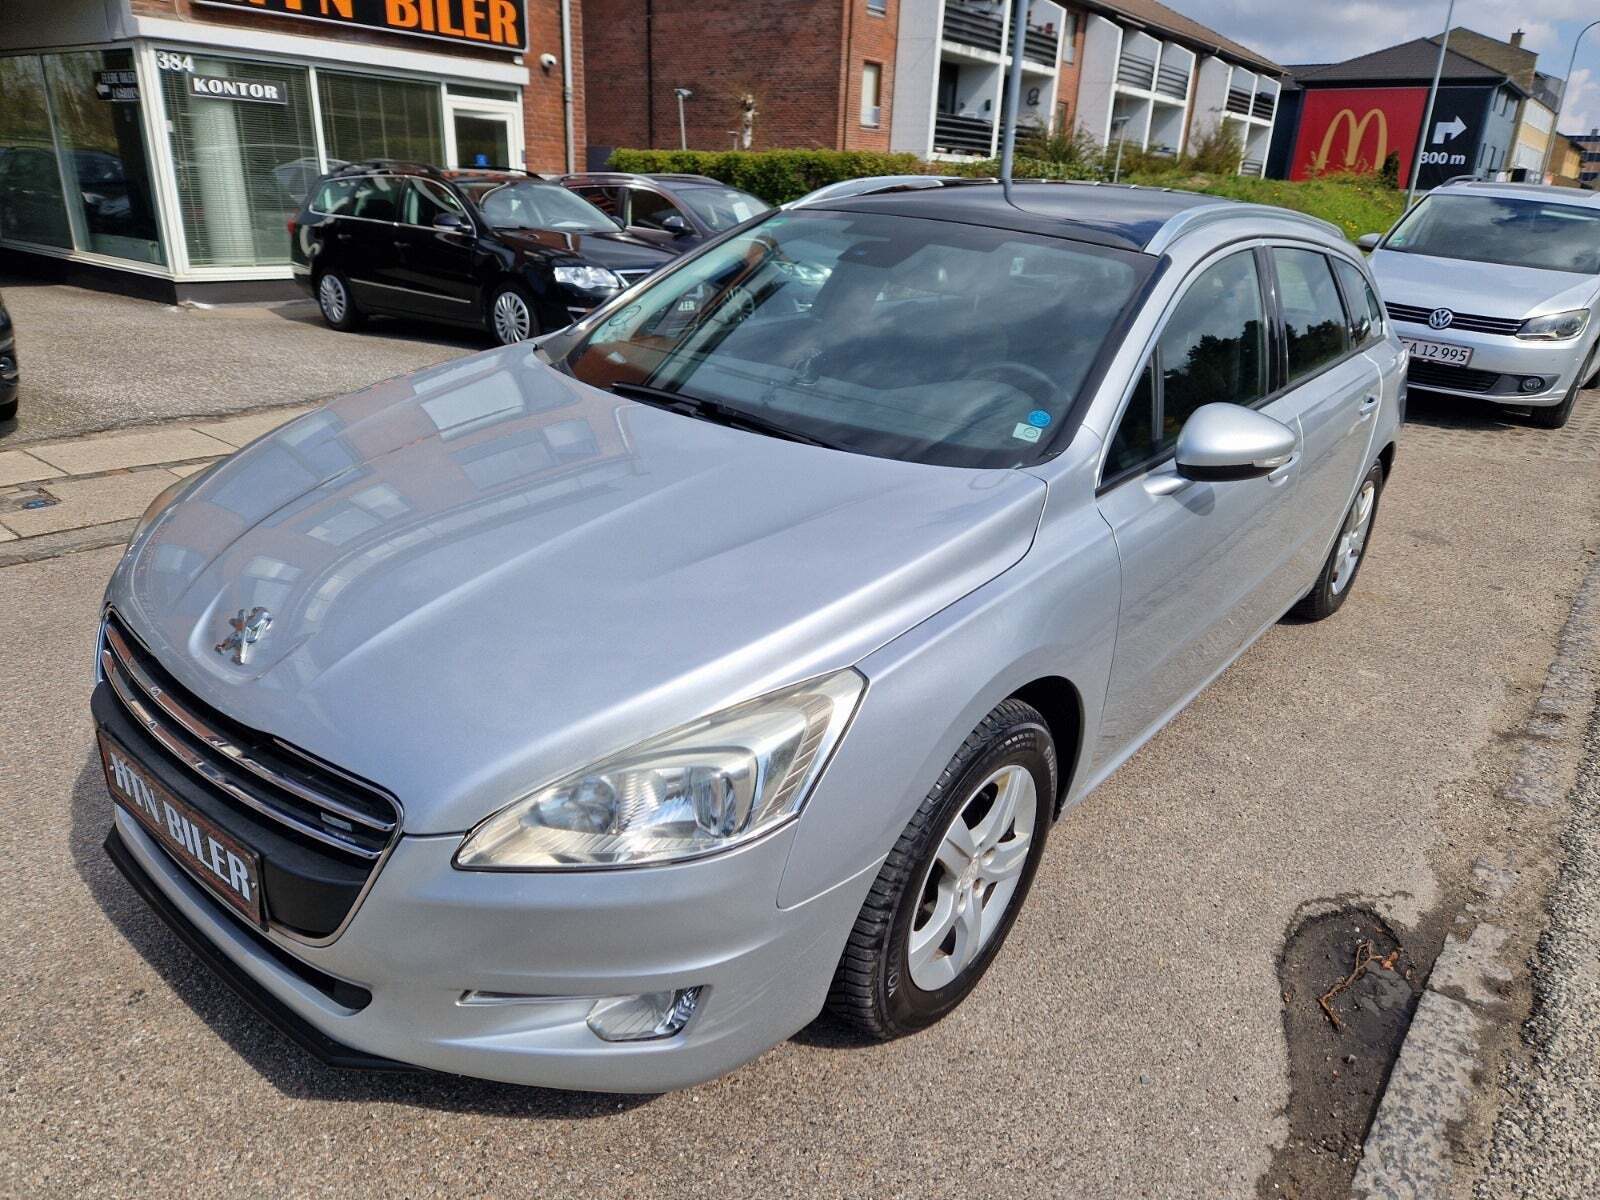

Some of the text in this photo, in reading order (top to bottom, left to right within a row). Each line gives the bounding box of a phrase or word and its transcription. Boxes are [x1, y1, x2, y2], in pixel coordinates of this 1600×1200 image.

[384, 0, 519, 46] BILER
[157, 52, 194, 72] 384
[193, 77, 278, 99] KONTOR
[1420, 152, 1466, 165] 300 m
[1402, 341, 1468, 362] A 12 995
[110, 752, 251, 902] HTN BILER
